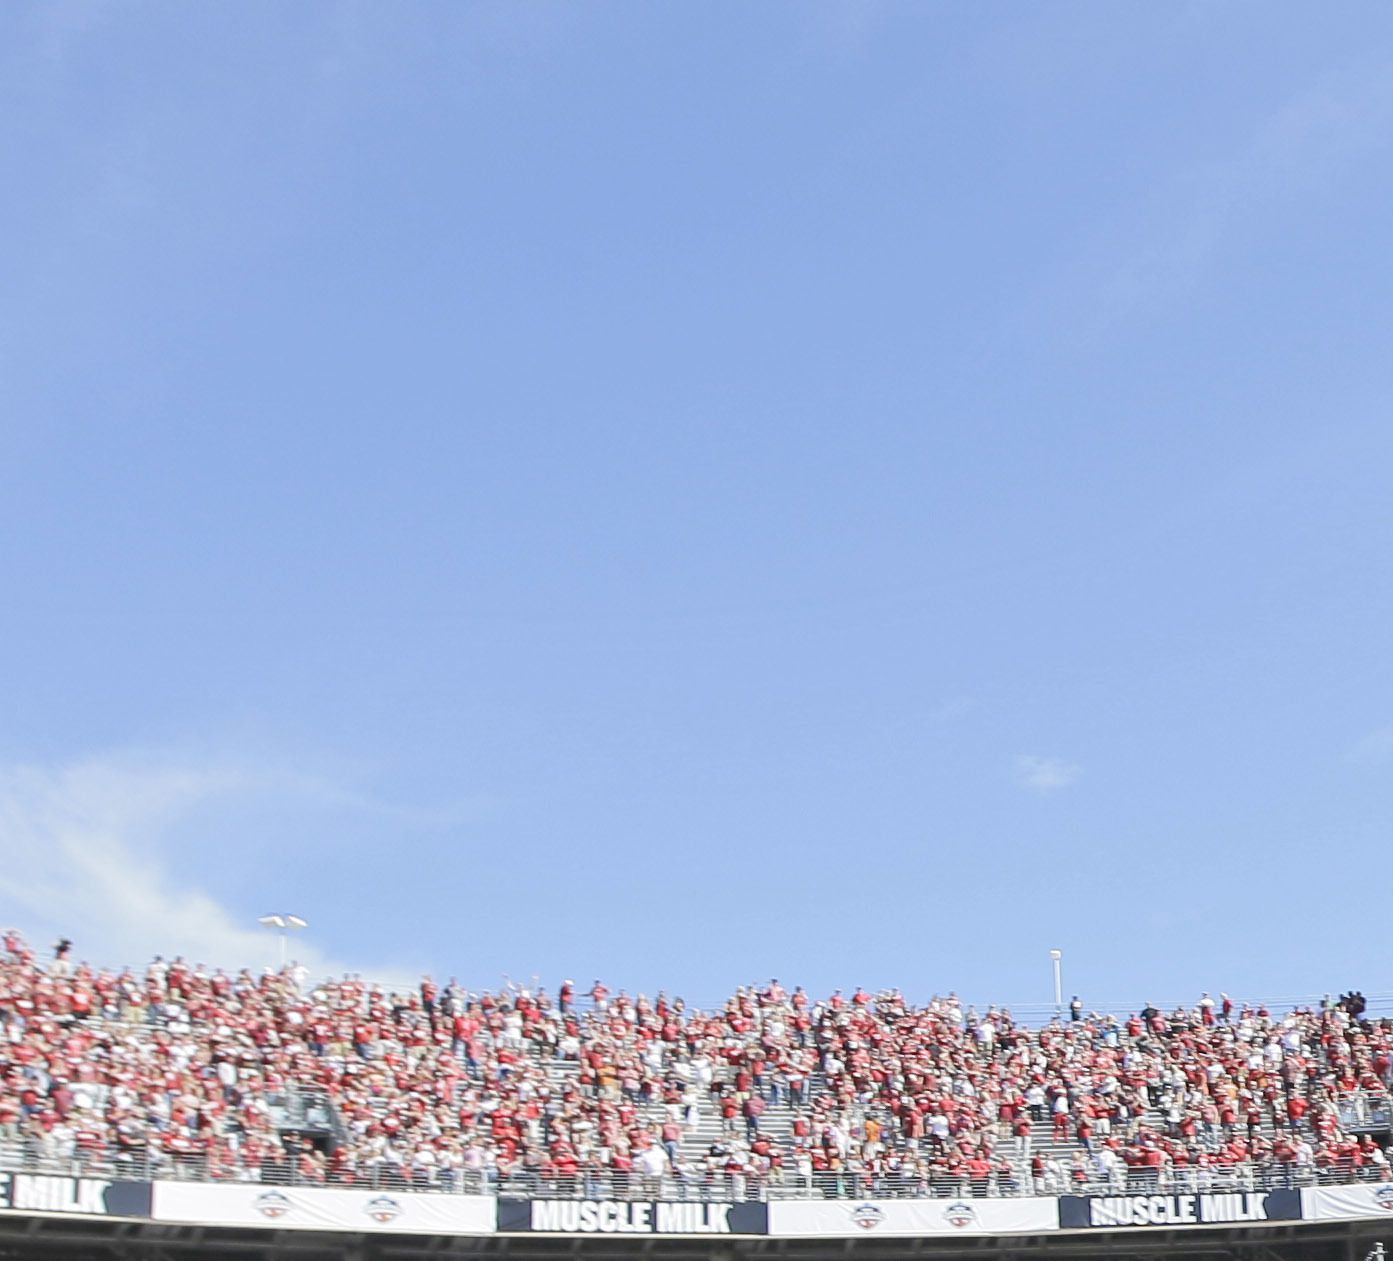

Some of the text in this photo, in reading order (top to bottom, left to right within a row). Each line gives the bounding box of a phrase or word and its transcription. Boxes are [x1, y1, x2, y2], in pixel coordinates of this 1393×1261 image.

[13, 1173, 112, 1214] MILK
[1090, 1191, 1270, 1226] MUSCLE MILK
[531, 1200, 733, 1234] MUSCLE MILK
